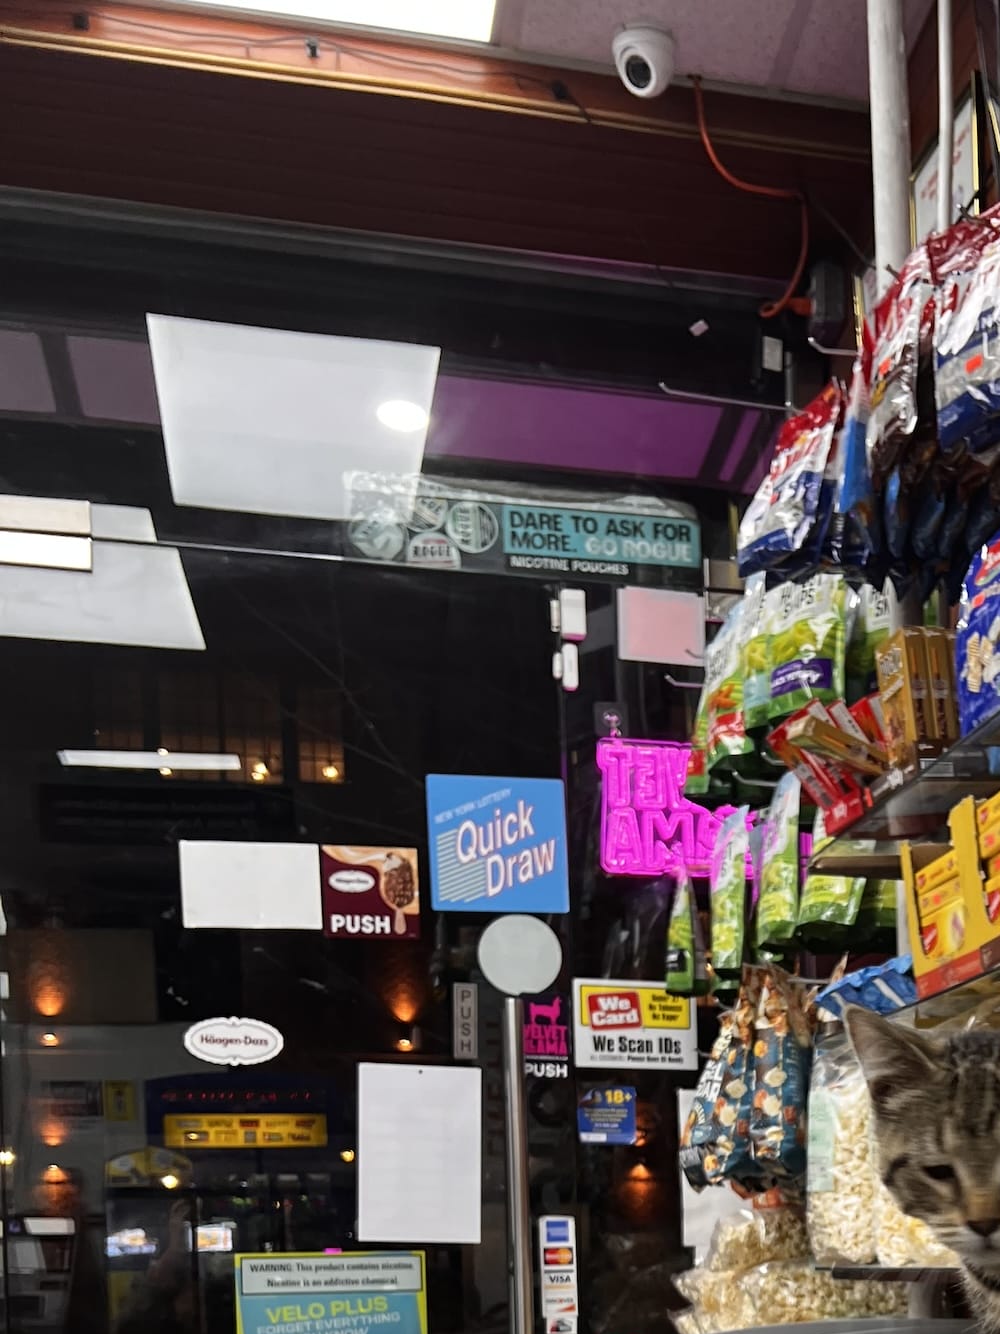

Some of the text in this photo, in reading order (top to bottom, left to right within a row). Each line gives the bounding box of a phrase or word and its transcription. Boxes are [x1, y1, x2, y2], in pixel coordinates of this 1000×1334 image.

[509, 511, 692, 543] DARE TO ASK FOR
[510, 531, 693, 563] MORE. GO ROGUE
[510, 555, 629, 576] NICOTINE POUCHES
[456, 800, 535, 864] Quick
[486, 838, 556, 897] Draw
[331, 914, 391, 934] PUSH
[597, 995, 632, 1012] We
[460, 990, 472, 1053] PUSH
[592, 1009, 640, 1026] Card
[593, 1035, 615, 1053] We
[618, 1036, 653, 1055] Scan
[659, 1037, 682, 1055] IDs
[525, 1062, 568, 1078] PUSH
[605, 1089, 632, 1104] 18+
[549, 1275, 571, 1283] VISA
[265, 1296, 388, 1323] VELO PLUS
[315, 1311, 400, 1330] EVERYTHING
